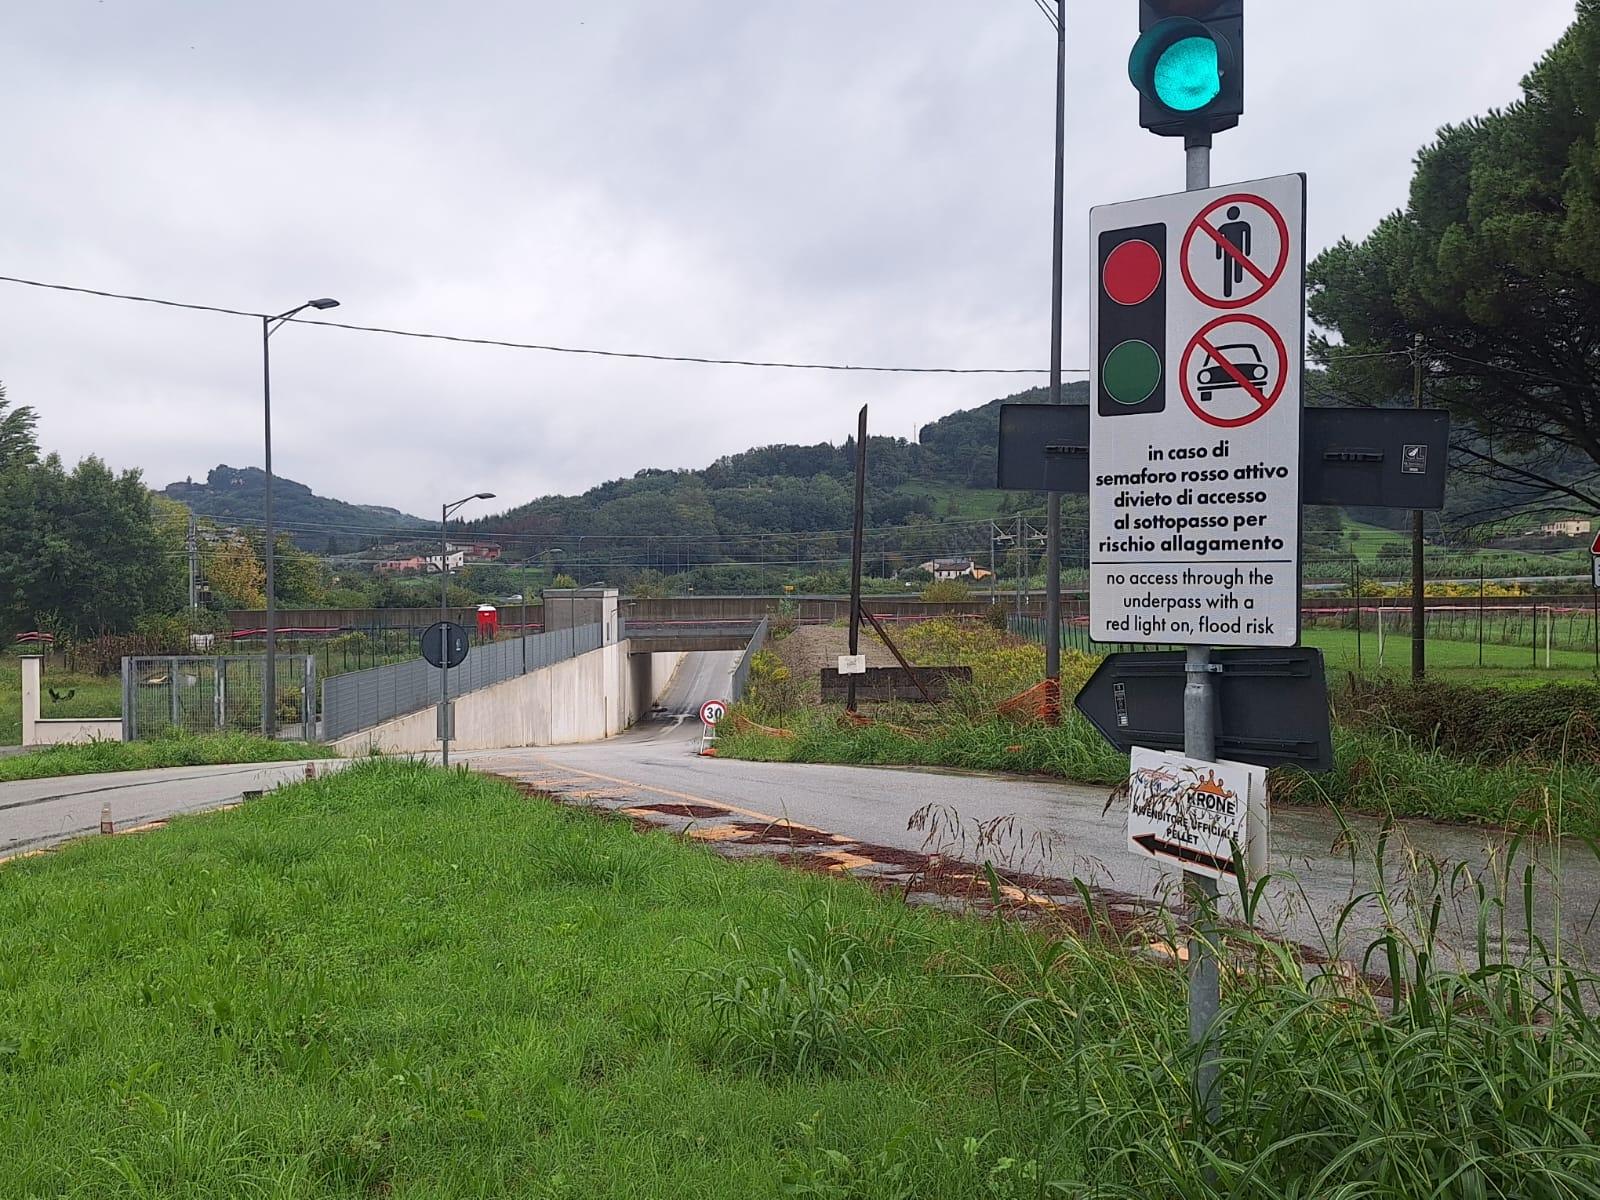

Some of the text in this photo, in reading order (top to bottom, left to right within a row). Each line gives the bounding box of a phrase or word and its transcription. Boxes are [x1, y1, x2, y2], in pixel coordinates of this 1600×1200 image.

[1148, 440, 1229, 461] in caso di
[1096, 462, 1288, 486] semaforo rosso attivo
[1114, 489, 1267, 507] divieto di accesso
[1114, 514, 1267, 533] al sottopasso per
[1099, 535, 1284, 555] rischio allagamento
[1107, 568, 1274, 589] no access through the
[1123, 592, 1254, 612] underpass with a
[1106, 615, 1274, 637] red light on, flood risk
[706, 707, 722, 720] 30
[1187, 792, 1236, 815] KRONE
[1166, 828, 1200, 845] PELLET
